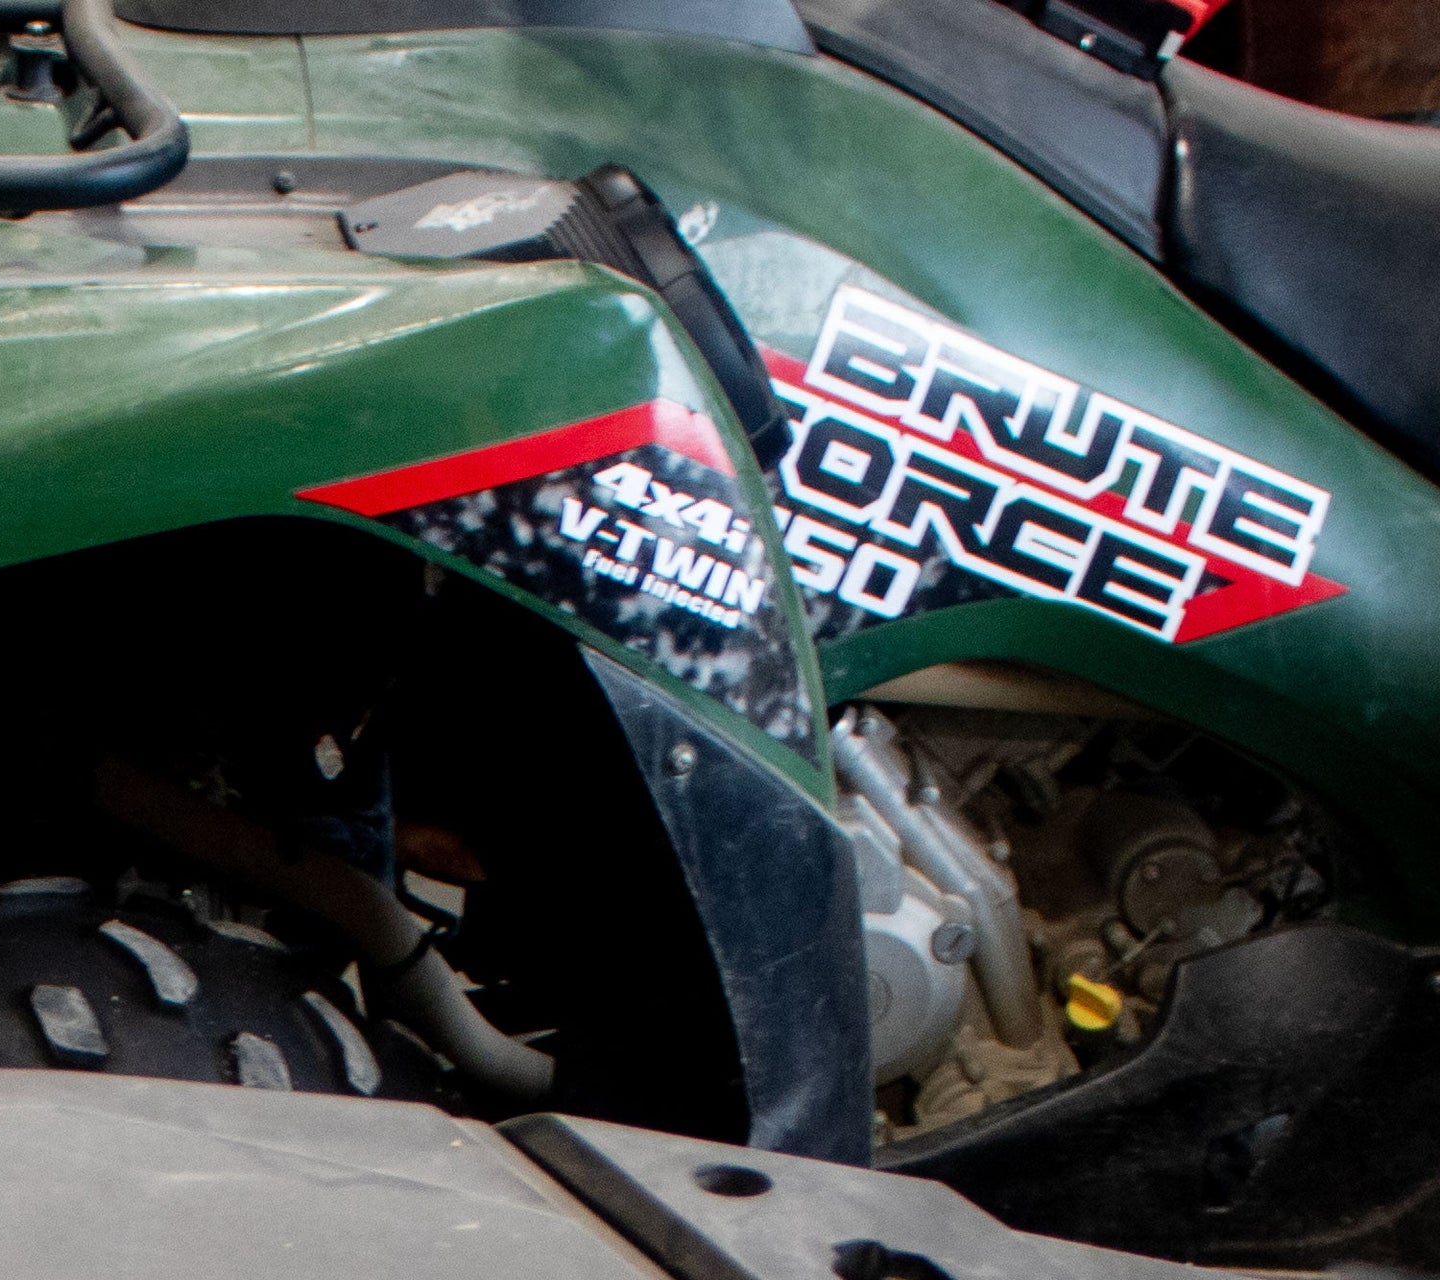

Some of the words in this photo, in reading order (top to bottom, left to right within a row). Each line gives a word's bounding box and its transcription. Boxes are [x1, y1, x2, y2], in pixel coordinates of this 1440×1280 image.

[807, 286, 1330, 585] BRUTE
[556, 496, 765, 615] V-TWIN
[593, 461, 751, 553] 4x4i
[773, 504, 921, 619] 50
[582, 548, 639, 586] Fuel
[640, 571, 742, 630] Injected
